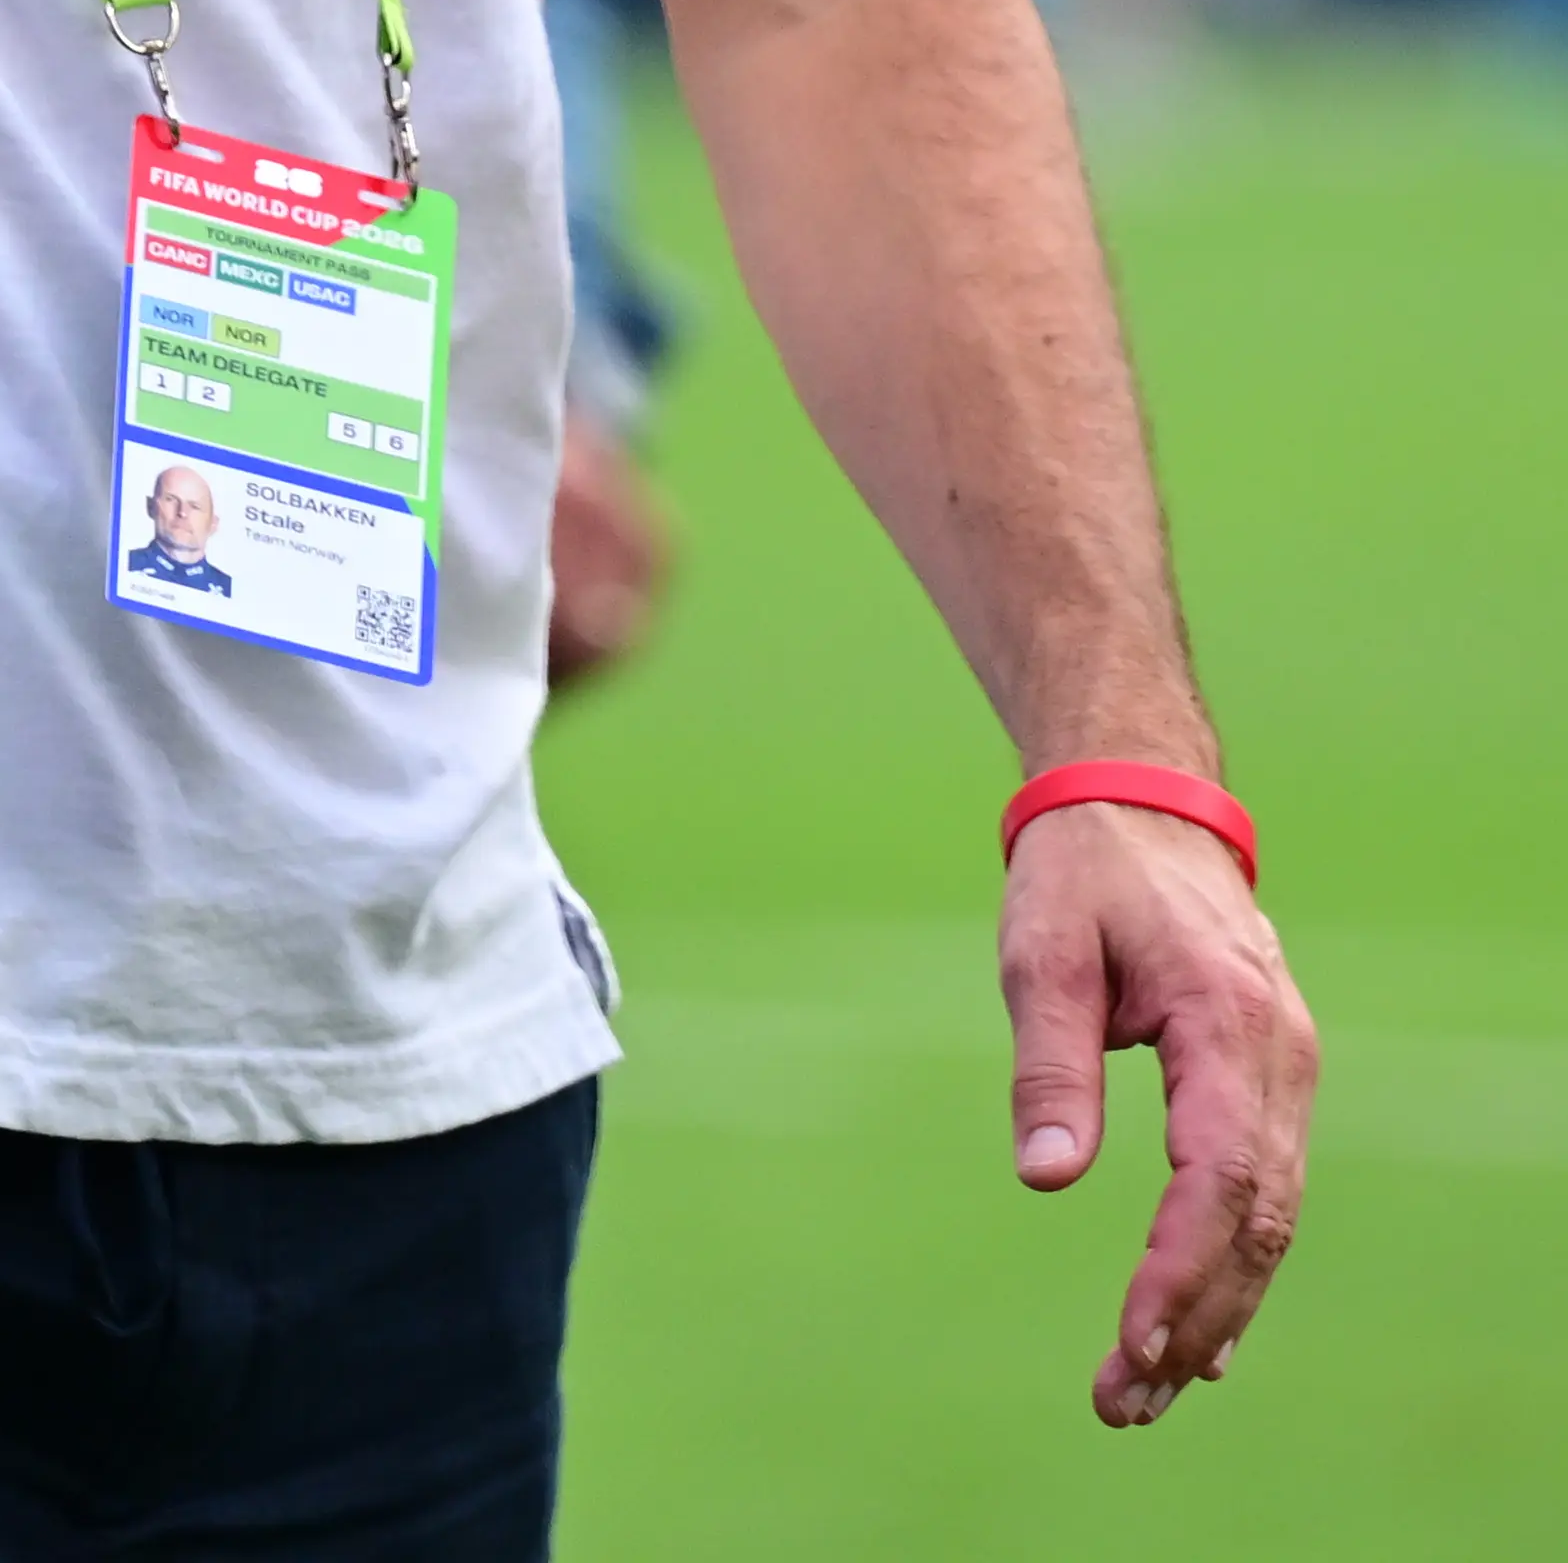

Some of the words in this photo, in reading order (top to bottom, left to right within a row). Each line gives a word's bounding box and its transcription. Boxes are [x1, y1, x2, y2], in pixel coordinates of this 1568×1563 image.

[149, 166, 200, 197] FIFA
[202, 181, 288, 218] WORLD
[291, 205, 338, 231] CUP
[341, 219, 424, 255] 2026
[148, 241, 208, 270] CANC
[220, 260, 280, 289] MEXC
[292, 279, 352, 308] USAC
[205, 226, 322, 268] TOURNAMENT
[325, 258, 372, 281] PASS
[153, 305, 195, 328] NOR
[224, 324, 268, 348] NOR
[144, 337, 208, 366] TEAM
[213, 355, 329, 398] DELEGATE
[156, 373, 167, 389] 1
[202, 385, 216, 402] 2
[342, 422, 357, 439] 5
[388, 434, 404, 451] 6
[245, 506, 305, 535] Stale
[246, 482, 377, 528] SOLBAKKEN
[245, 527, 285, 548] Team
